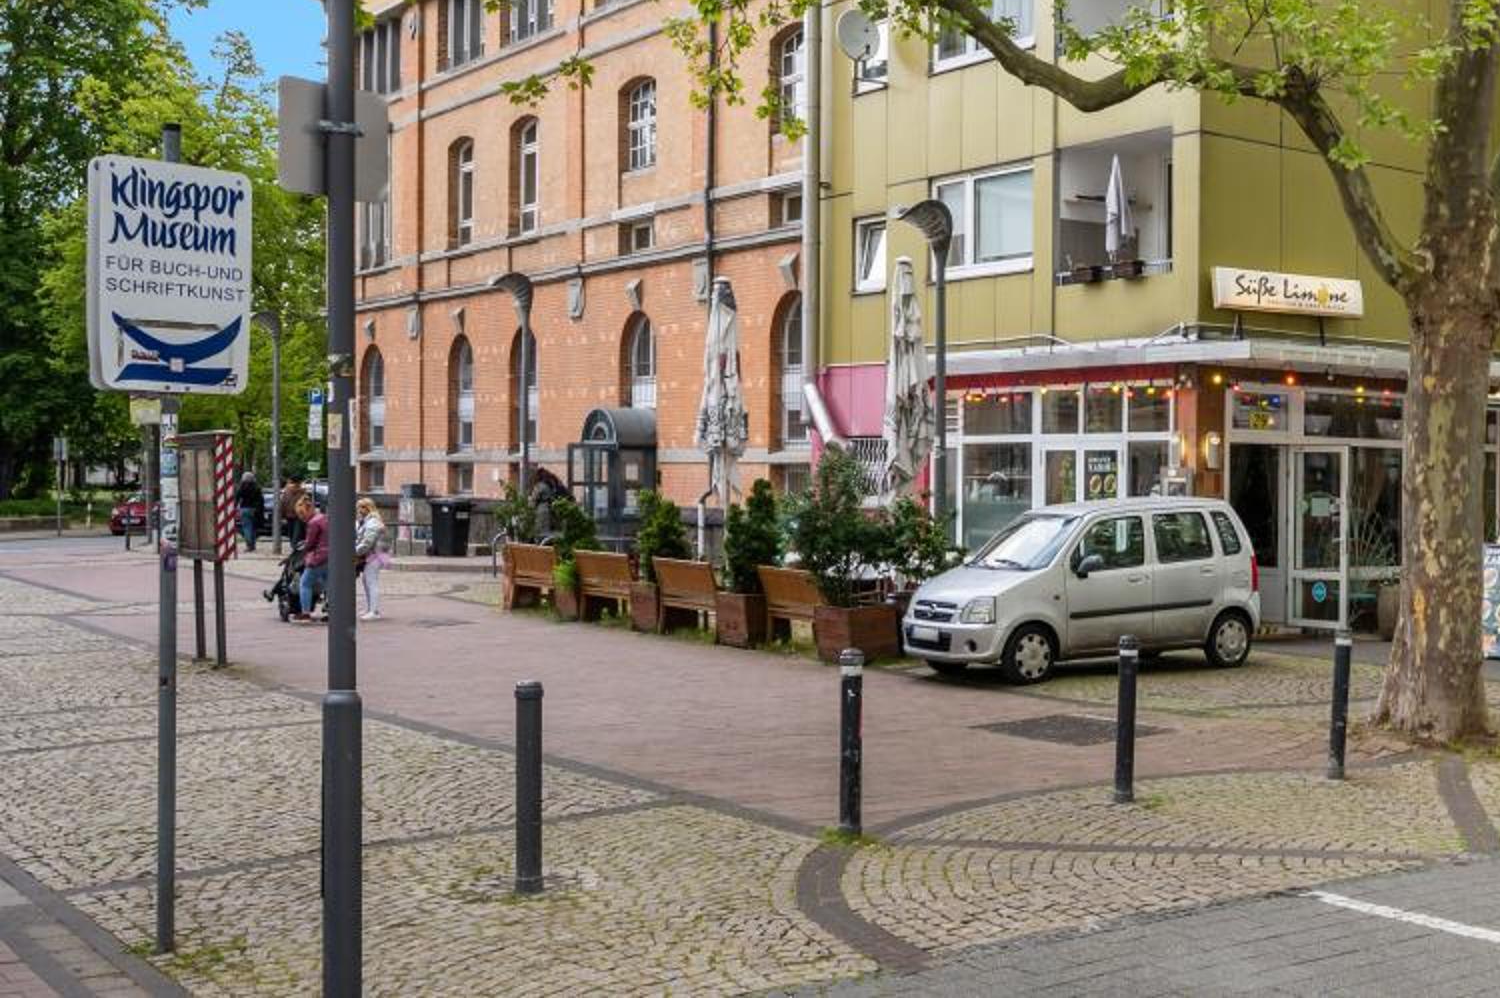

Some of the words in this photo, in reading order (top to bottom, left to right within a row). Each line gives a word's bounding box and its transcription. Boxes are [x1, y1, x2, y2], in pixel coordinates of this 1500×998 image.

[111, 166, 244, 221] Klingspor
[108, 210, 236, 257] Museum
[106, 255, 144, 273] FÜR
[106, 277, 245, 302] SCHRIFTKUNST
[1235, 273, 1277, 304] Süße
